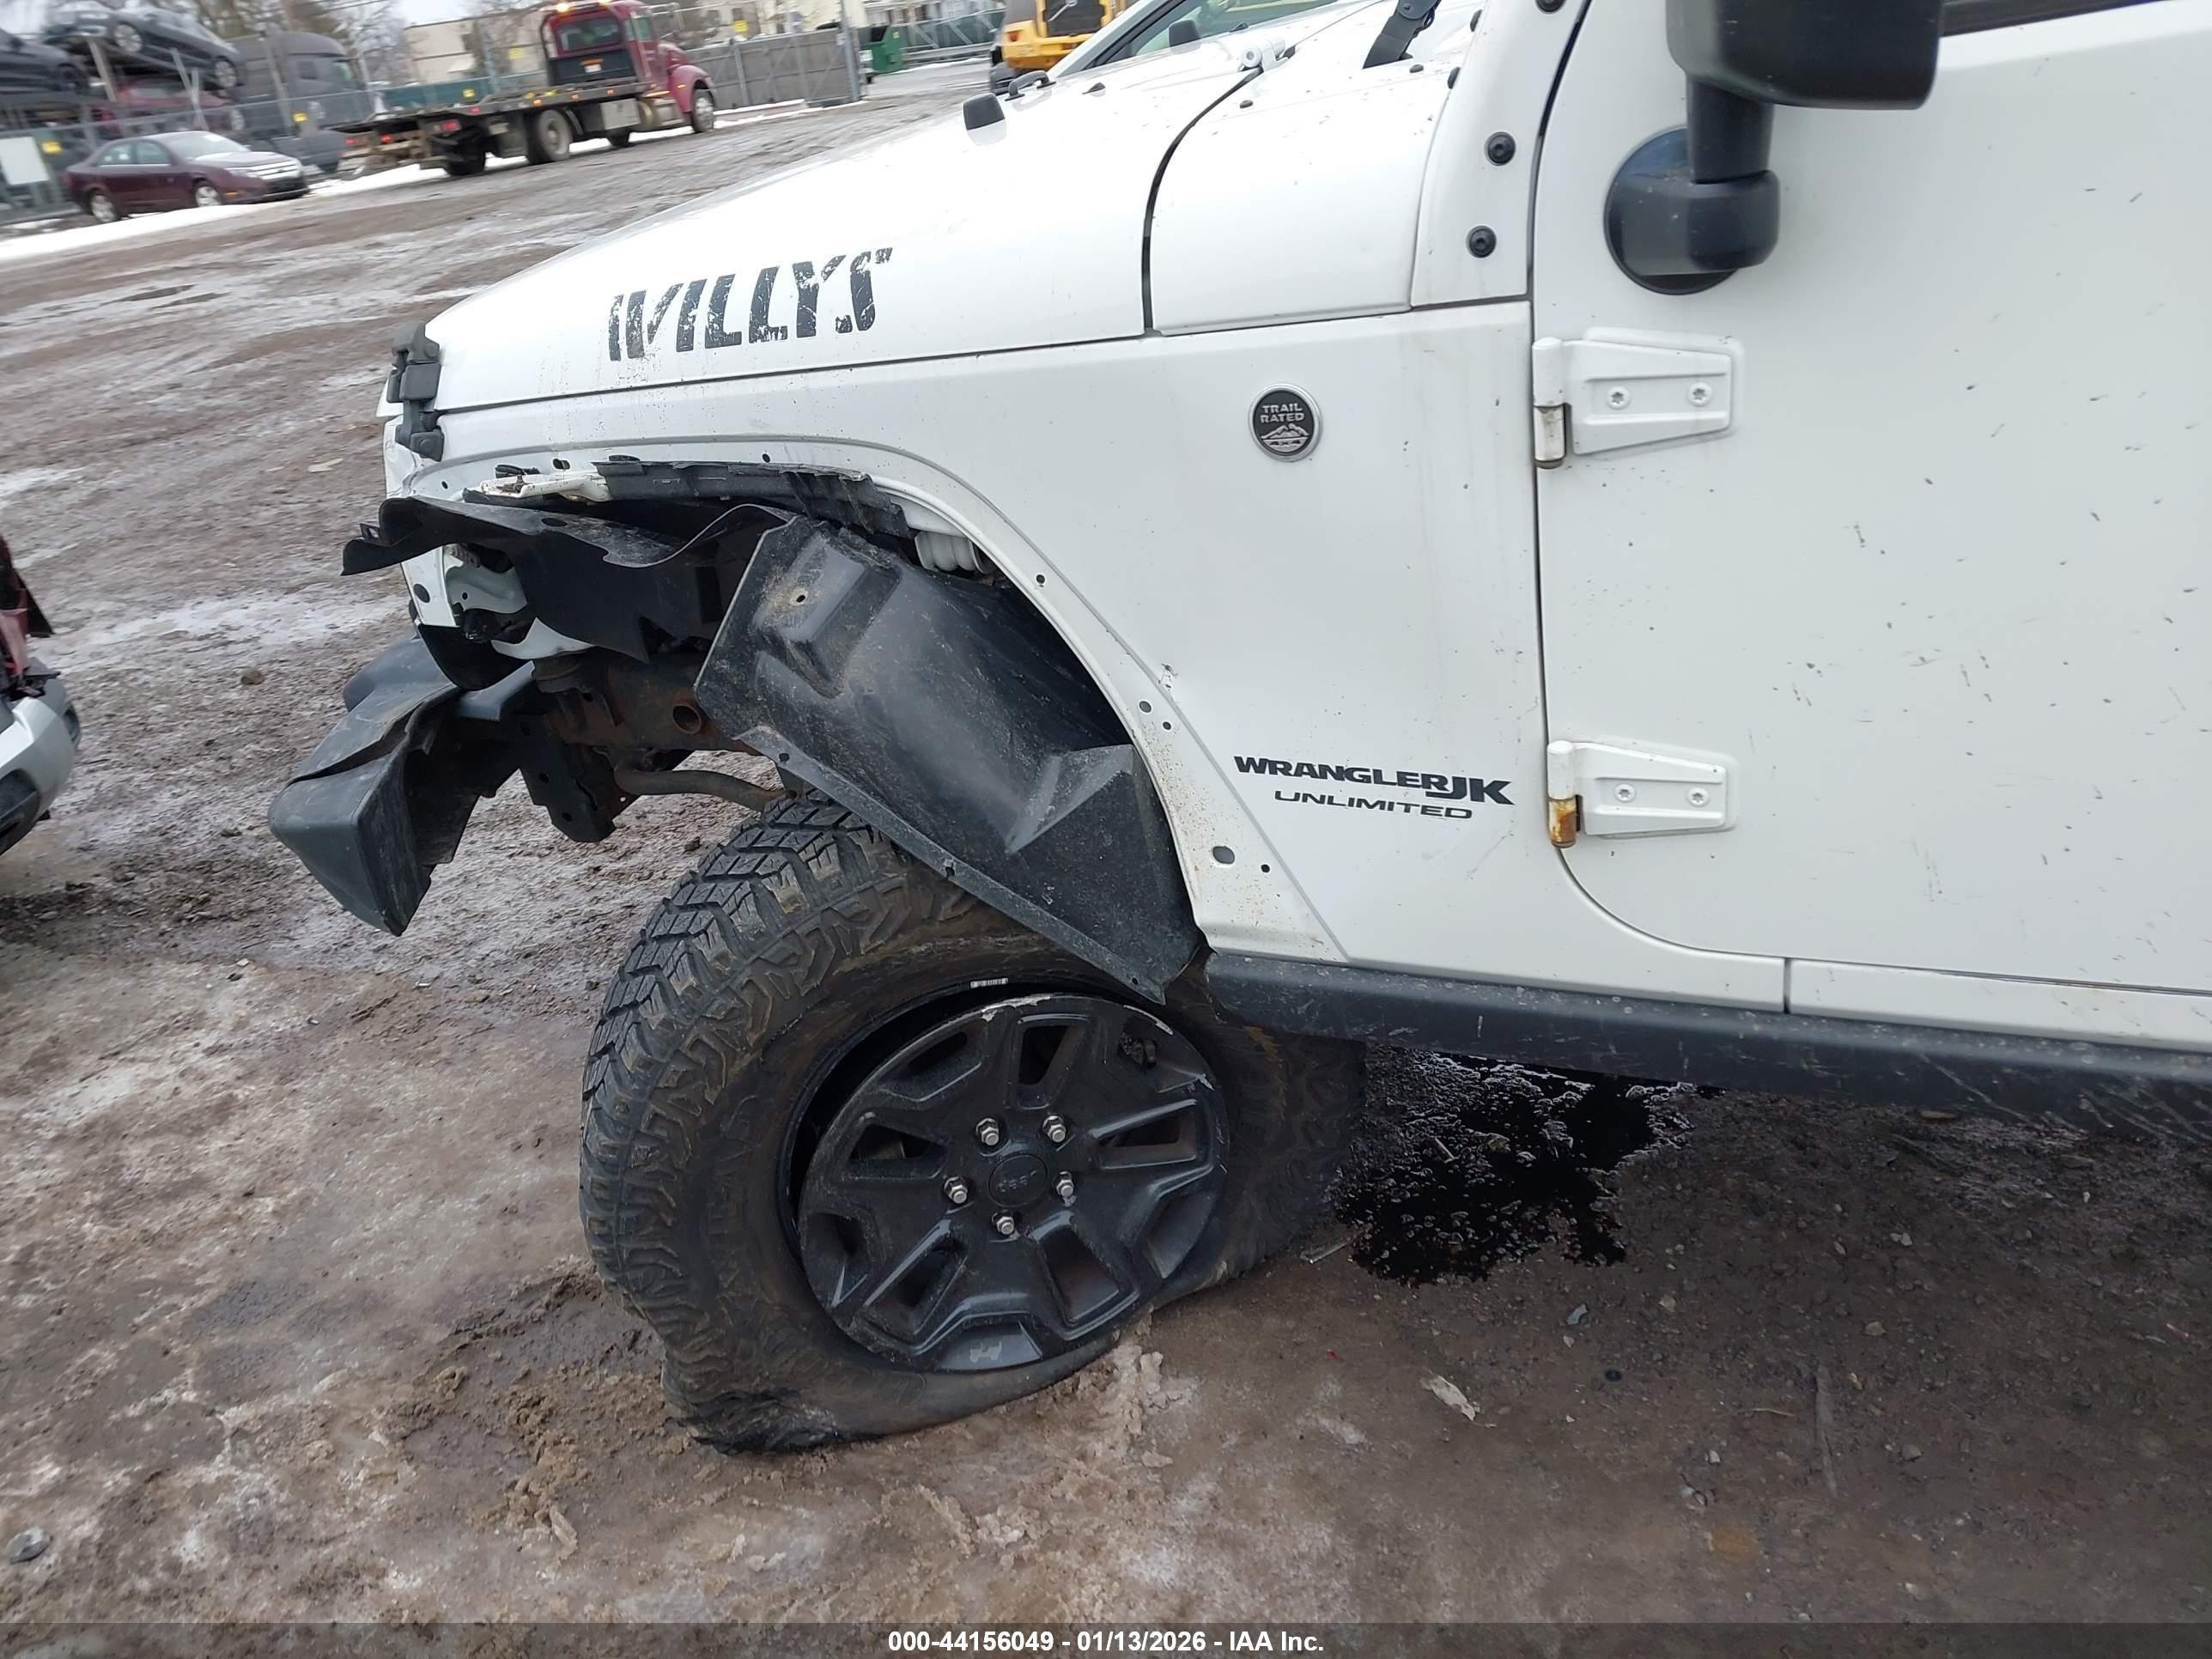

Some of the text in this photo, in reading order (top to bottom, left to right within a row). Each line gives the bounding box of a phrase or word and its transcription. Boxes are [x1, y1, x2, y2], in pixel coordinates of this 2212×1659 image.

[609, 247, 893, 362] WILLYS
[1259, 412, 1305, 423] RATED
[1261, 403, 1303, 414] TRAIL
[1273, 790, 1473, 819] UNLIMITED
